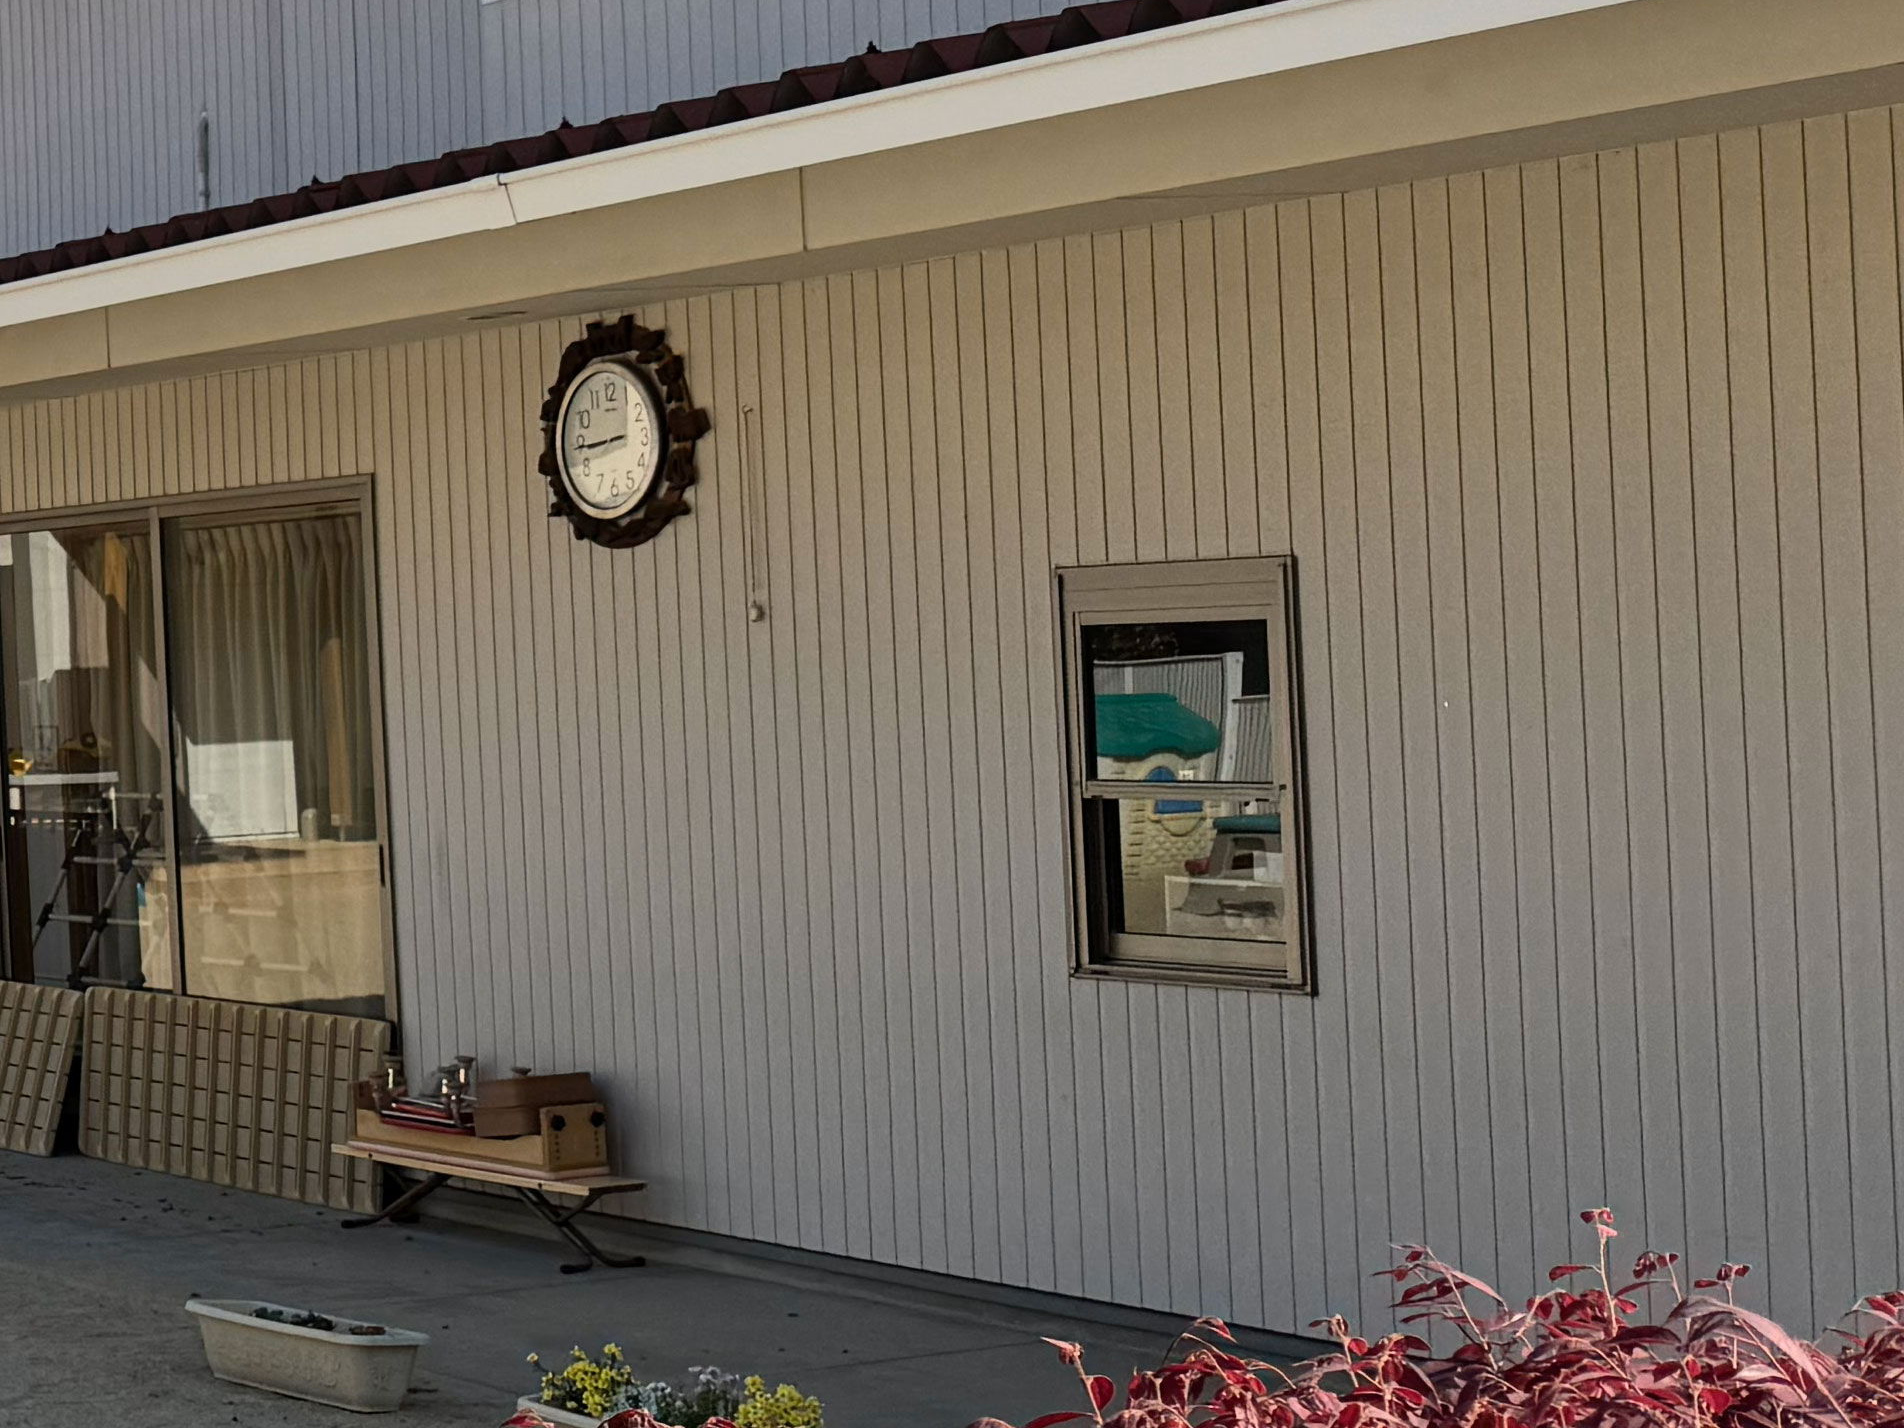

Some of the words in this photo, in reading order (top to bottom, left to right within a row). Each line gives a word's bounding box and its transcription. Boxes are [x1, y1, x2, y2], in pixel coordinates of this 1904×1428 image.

[589, 389, 600, 409] 11
[604, 382, 616, 402] 12
[577, 409, 591, 429] 10
[635, 403, 644, 422] 2
[641, 427, 649, 447] 3
[582, 458, 591, 477] 8
[637, 452, 645, 468] 4
[597, 474, 604, 493] 7
[610, 476, 619, 497] 6
[626, 471, 635, 490] 5
